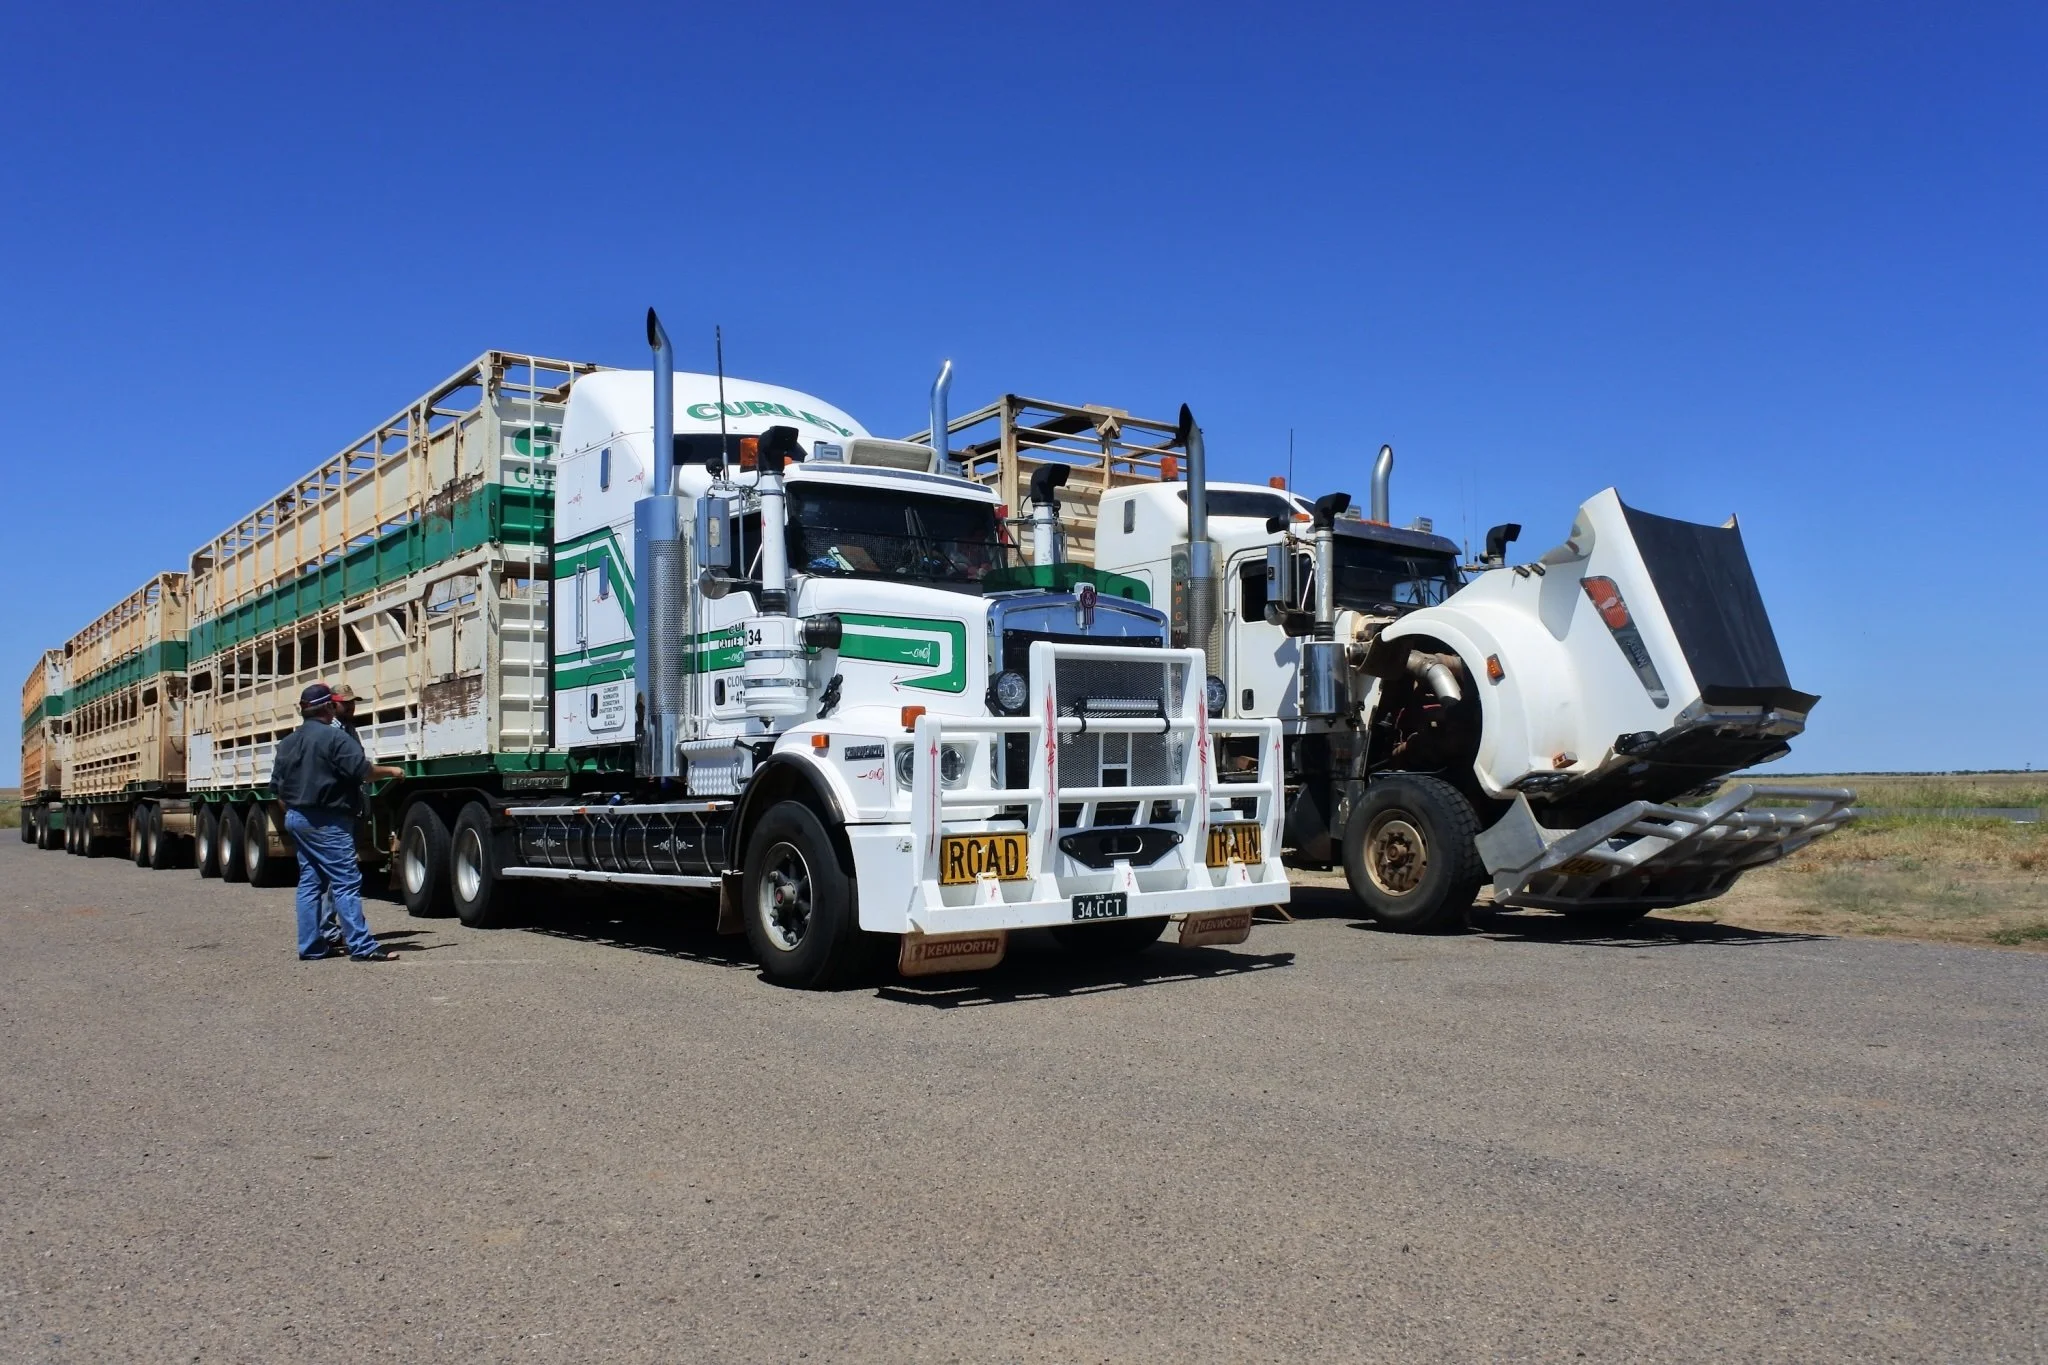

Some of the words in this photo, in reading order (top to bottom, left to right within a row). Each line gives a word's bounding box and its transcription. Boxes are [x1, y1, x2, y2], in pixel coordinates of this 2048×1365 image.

[687, 401, 854, 437] CURLEY
[749, 629, 762, 646] 34
[1209, 826, 1258, 863] TRAIN
[950, 839, 1019, 879] ROAD
[1200, 916, 1247, 931] KENWORTH
[927, 940, 997, 957] KENWORTH
